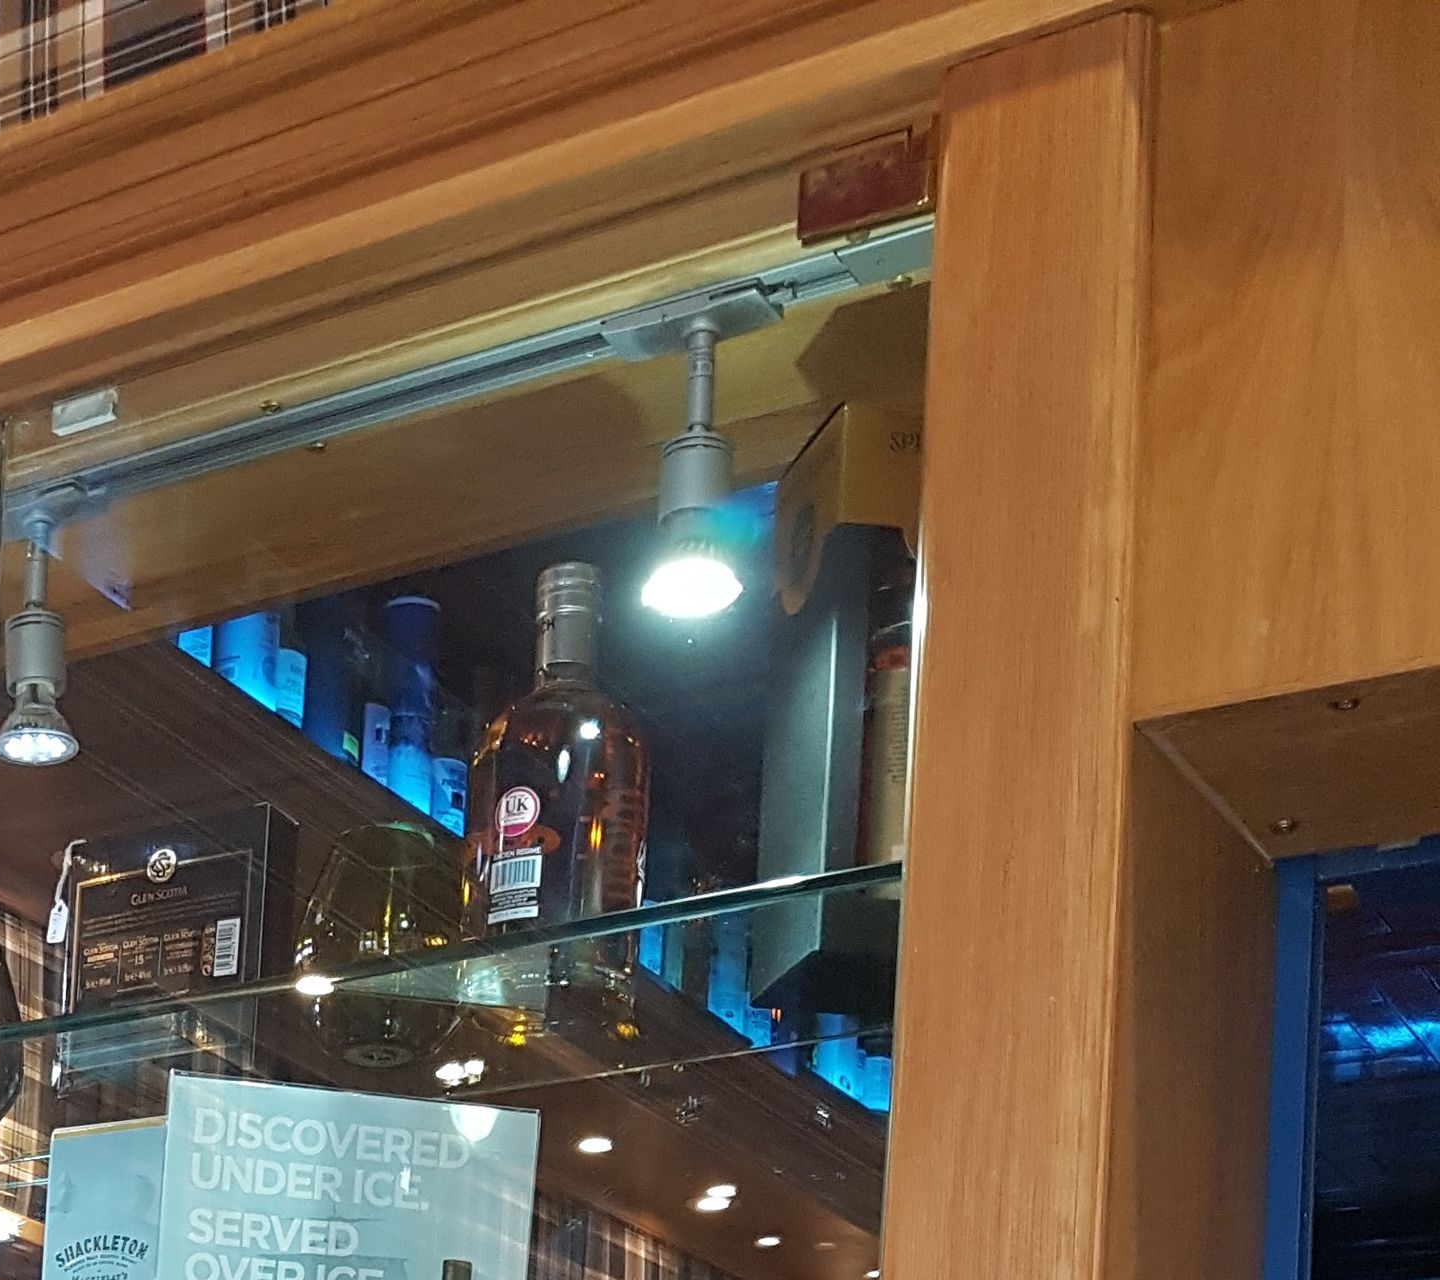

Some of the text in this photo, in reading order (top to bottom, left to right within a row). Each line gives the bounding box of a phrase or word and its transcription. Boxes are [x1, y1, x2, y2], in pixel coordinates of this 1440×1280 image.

[506, 797, 529, 814] UK
[193, 1106, 471, 1169] DISCOVERED
[190, 1158, 430, 1212] UNDER ICE.
[55, 1234, 149, 1269] SHACKLETON
[186, 1207, 360, 1257] SERVED
